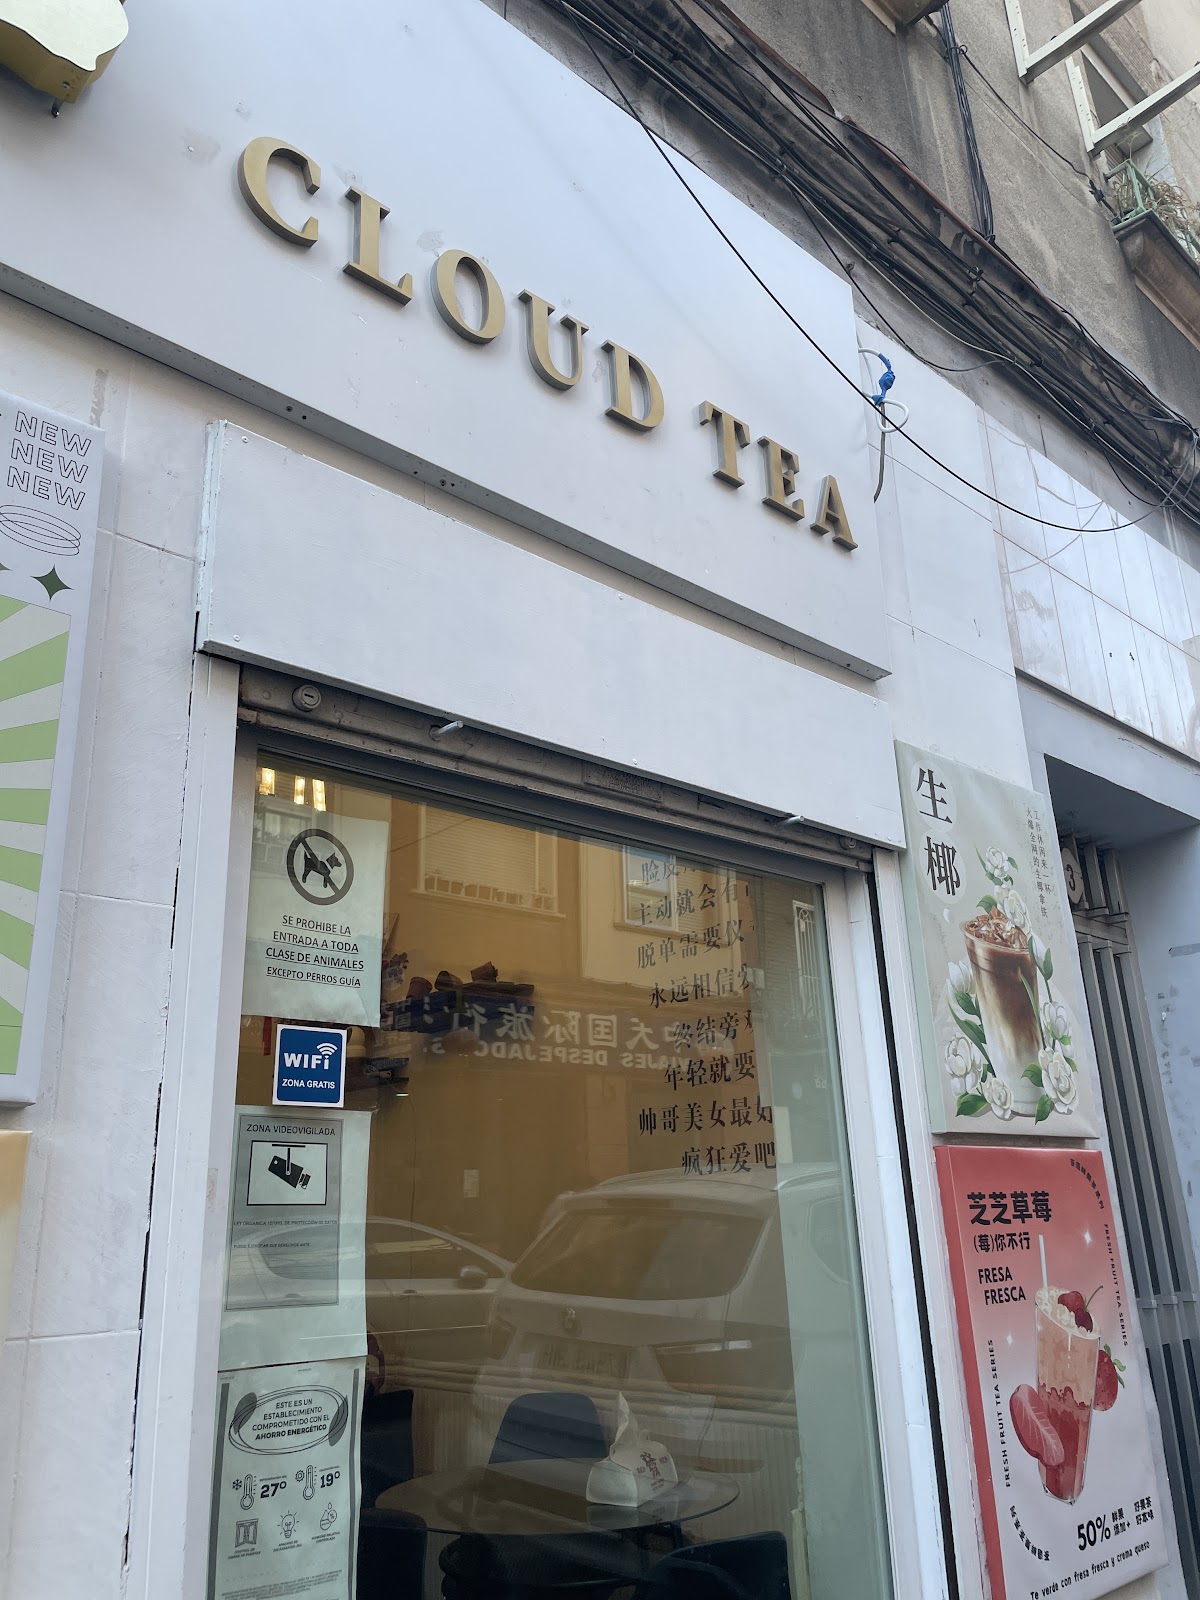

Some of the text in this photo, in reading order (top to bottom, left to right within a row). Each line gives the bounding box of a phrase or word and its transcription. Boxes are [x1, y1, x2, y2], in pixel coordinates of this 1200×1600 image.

[238, 136, 857, 551] CLOUD TEA
[15, 411, 92, 457] NEW
[11, 438, 88, 483] NEW
[7, 466, 86, 510] NEW
[637, 877, 749, 928] 主动就会有
[273, 930, 359, 953] ENTRADA A TODA
[282, 914, 351, 936] SE PROHIBE LA
[266, 947, 364, 970] CLASE DE ANIMALES
[637, 919, 755, 970] 脱单需要仪
[267, 966, 361, 987] EXCEPTO PERROS GUÍA
[282, 1078, 336, 1089] ZONA GRATIS
[246, 1123, 336, 1136] ZONA VIDEOVIGILADA
[680, 1141, 777, 1176] 疯狂爱吧
[967, 1190, 1052, 1226] 芝芝草莓
[973, 1232, 1030, 1254] (莓)你不行
[978, 1266, 1013, 1285] FRESA
[1104, 1223, 1113, 1254] FRESH
[1110, 1257, 1119, 1286] FRUIT
[1118, 1312, 1129, 1347] SERIES
[984, 1285, 1026, 1306] FRESCA
[988, 1339, 998, 1379] SERIES
[263, 1406, 322, 1421] ESTABLECIMIENTO
[276, 1398, 313, 1410] ESTE ES UN
[252, 1417, 309, 1431] COMPROMETIDO
[309, 1415, 322, 1424] CON
[255, 1424, 327, 1441] AHORRO ENERGÉTICO
[997, 1411, 1006, 1445] FRUIT
[1001, 1449, 1011, 1488] FRESH
[1077, 1514, 1111, 1551] 50%
[1041, 1582, 1059, 1598] verde
[1061, 1576, 1072, 1588] con
[1074, 1569, 1089, 1583] fresa
[1091, 1560, 1109, 1575] fresca
[1134, 1541, 1150, 1557] queso
